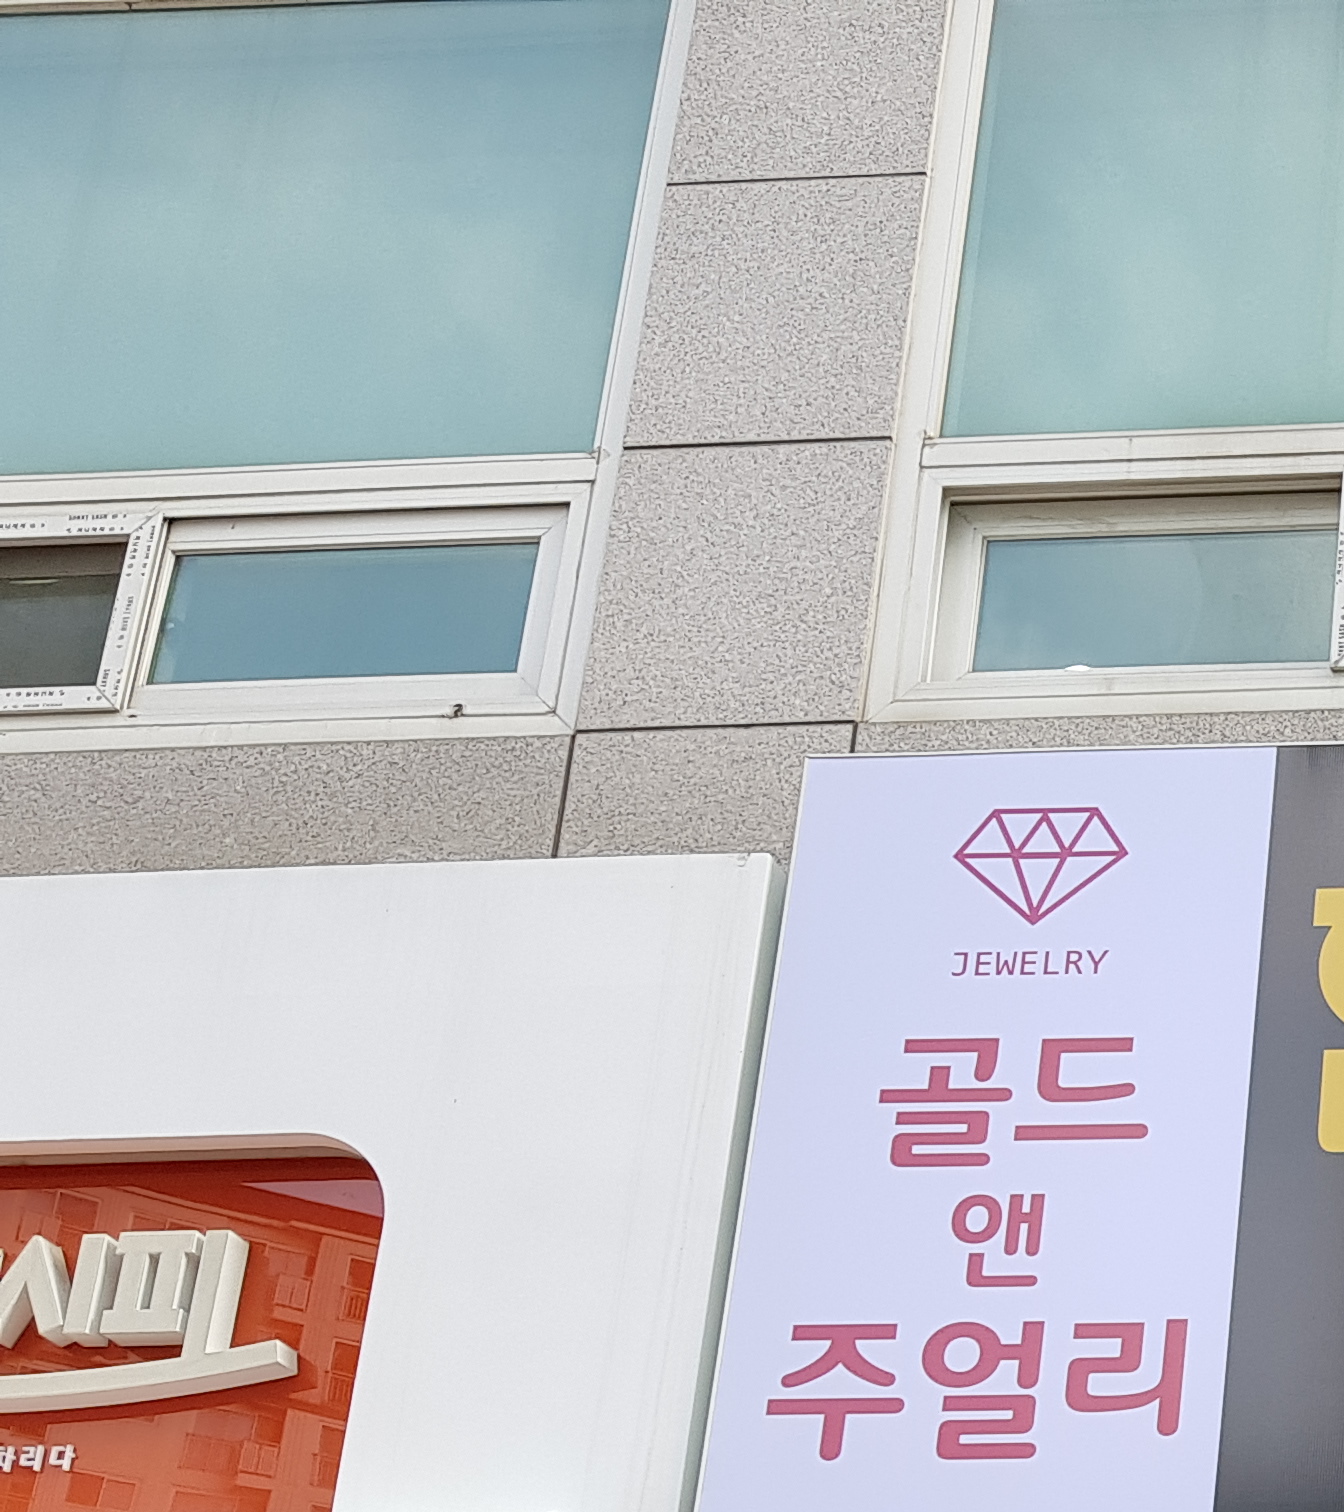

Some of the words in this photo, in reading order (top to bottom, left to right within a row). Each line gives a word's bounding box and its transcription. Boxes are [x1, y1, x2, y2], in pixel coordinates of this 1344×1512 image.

[951, 949, 1110, 977] JEWELRY
[878, 1036, 1149, 1168] 골드
[0, 1229, 262, 1368] 시피
[951, 1192, 1046, 1288] 앤
[765, 1318, 1189, 1461] 주얼리
